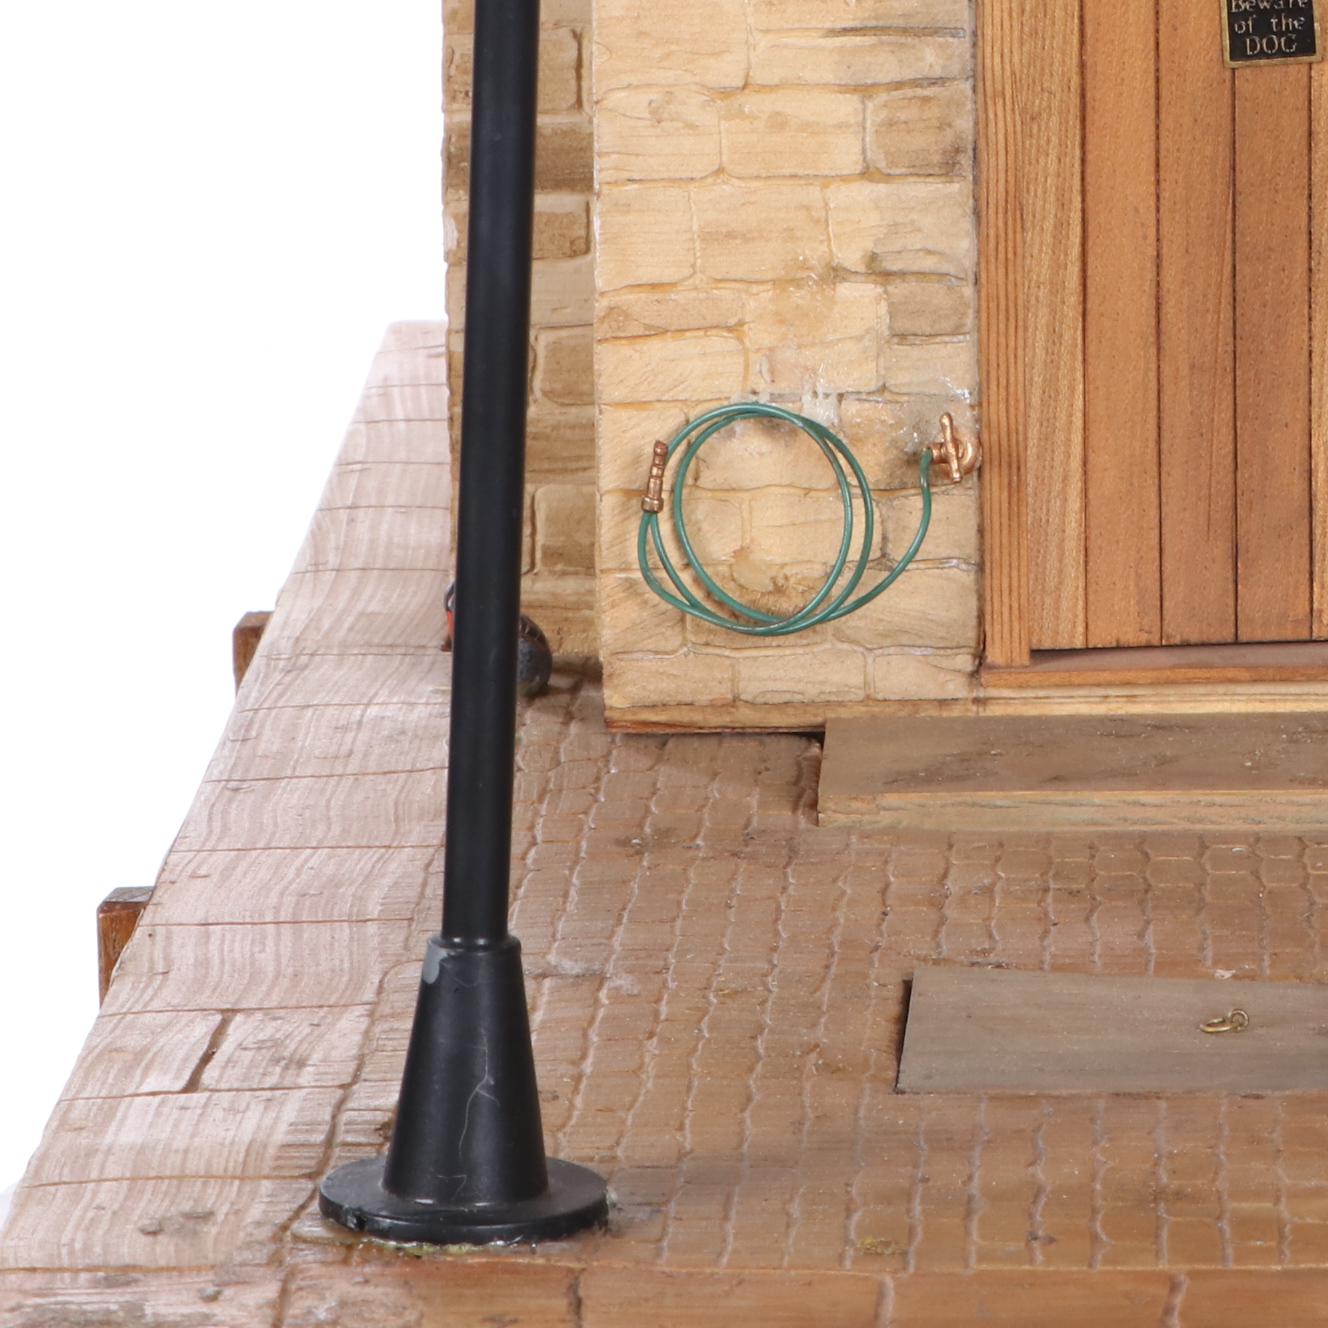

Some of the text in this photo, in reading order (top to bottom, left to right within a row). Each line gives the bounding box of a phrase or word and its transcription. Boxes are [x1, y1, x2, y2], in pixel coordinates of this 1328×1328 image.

[1234, 13, 1306, 34] of the
[1246, 33, 1297, 56] DOG
